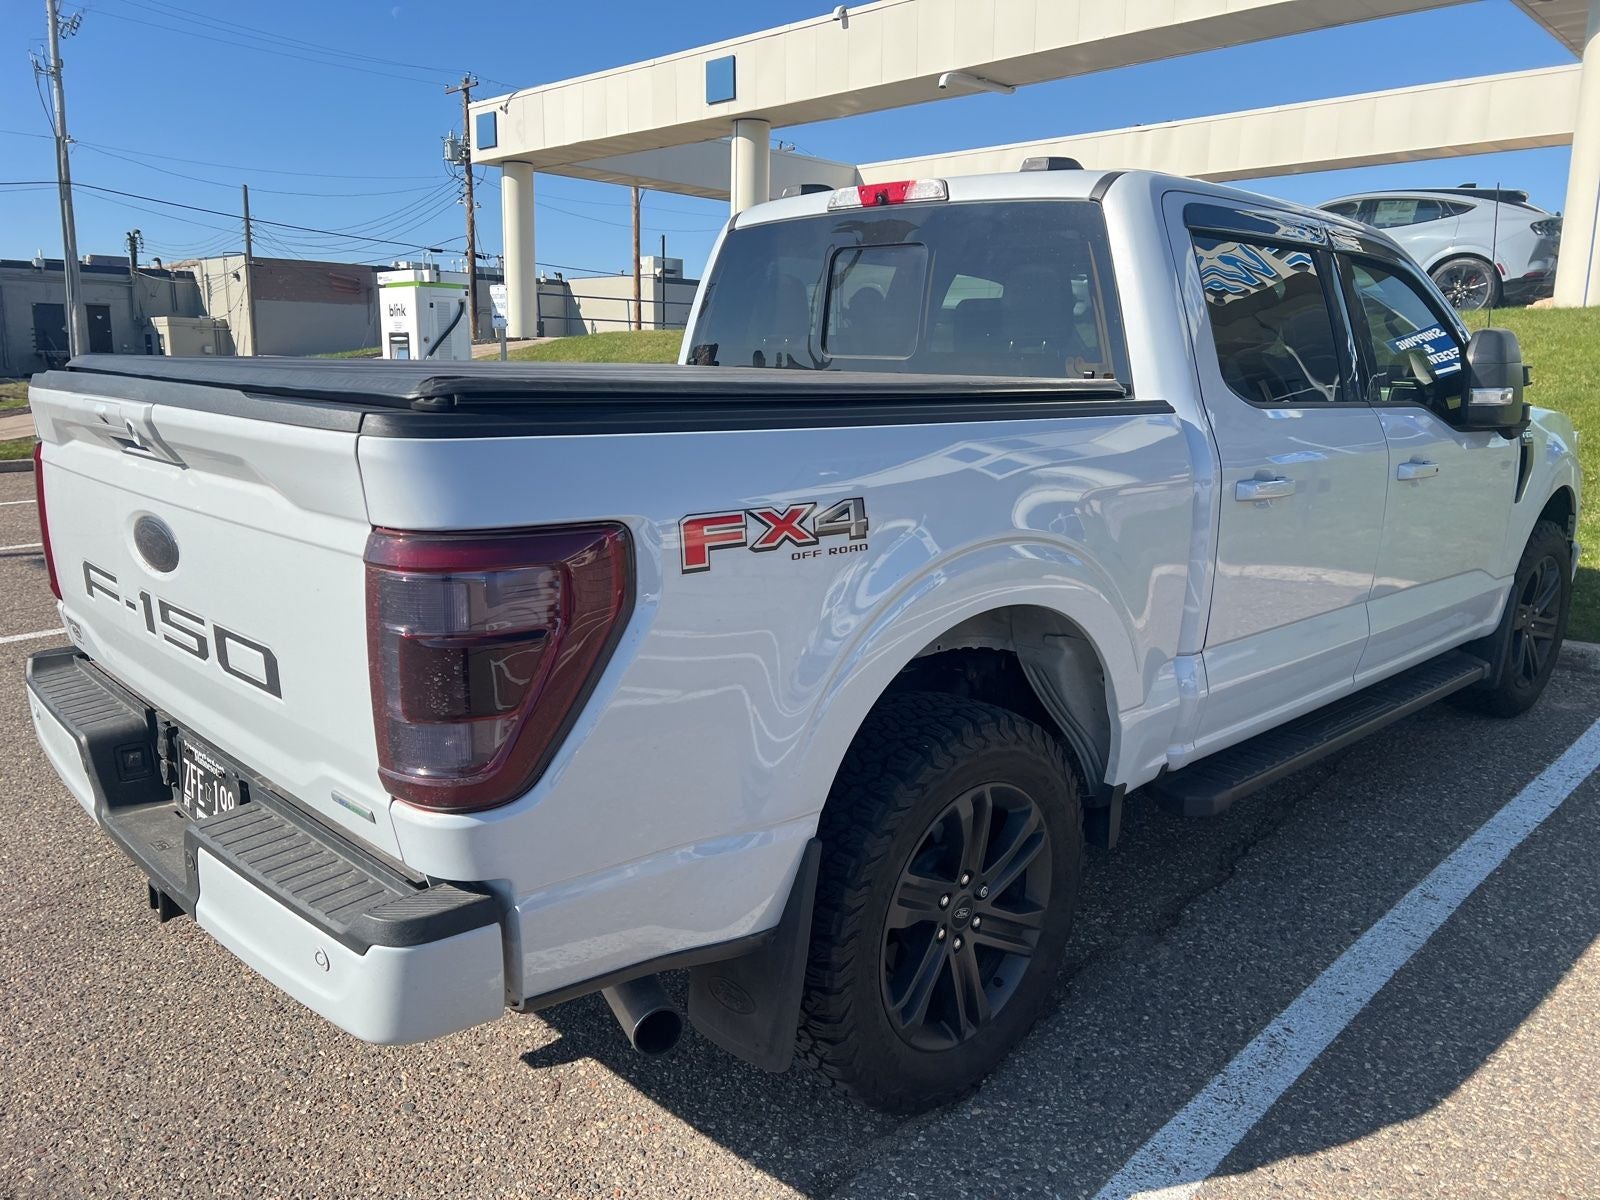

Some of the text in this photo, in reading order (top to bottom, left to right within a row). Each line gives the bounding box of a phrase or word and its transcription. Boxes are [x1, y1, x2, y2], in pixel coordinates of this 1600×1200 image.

[388, 303, 407, 317] blink
[678, 497, 869, 574] FX4
[791, 543, 869, 561] OFF ROAD
[82, 560, 283, 700] F-150
[183, 758, 206, 808] ZFE
